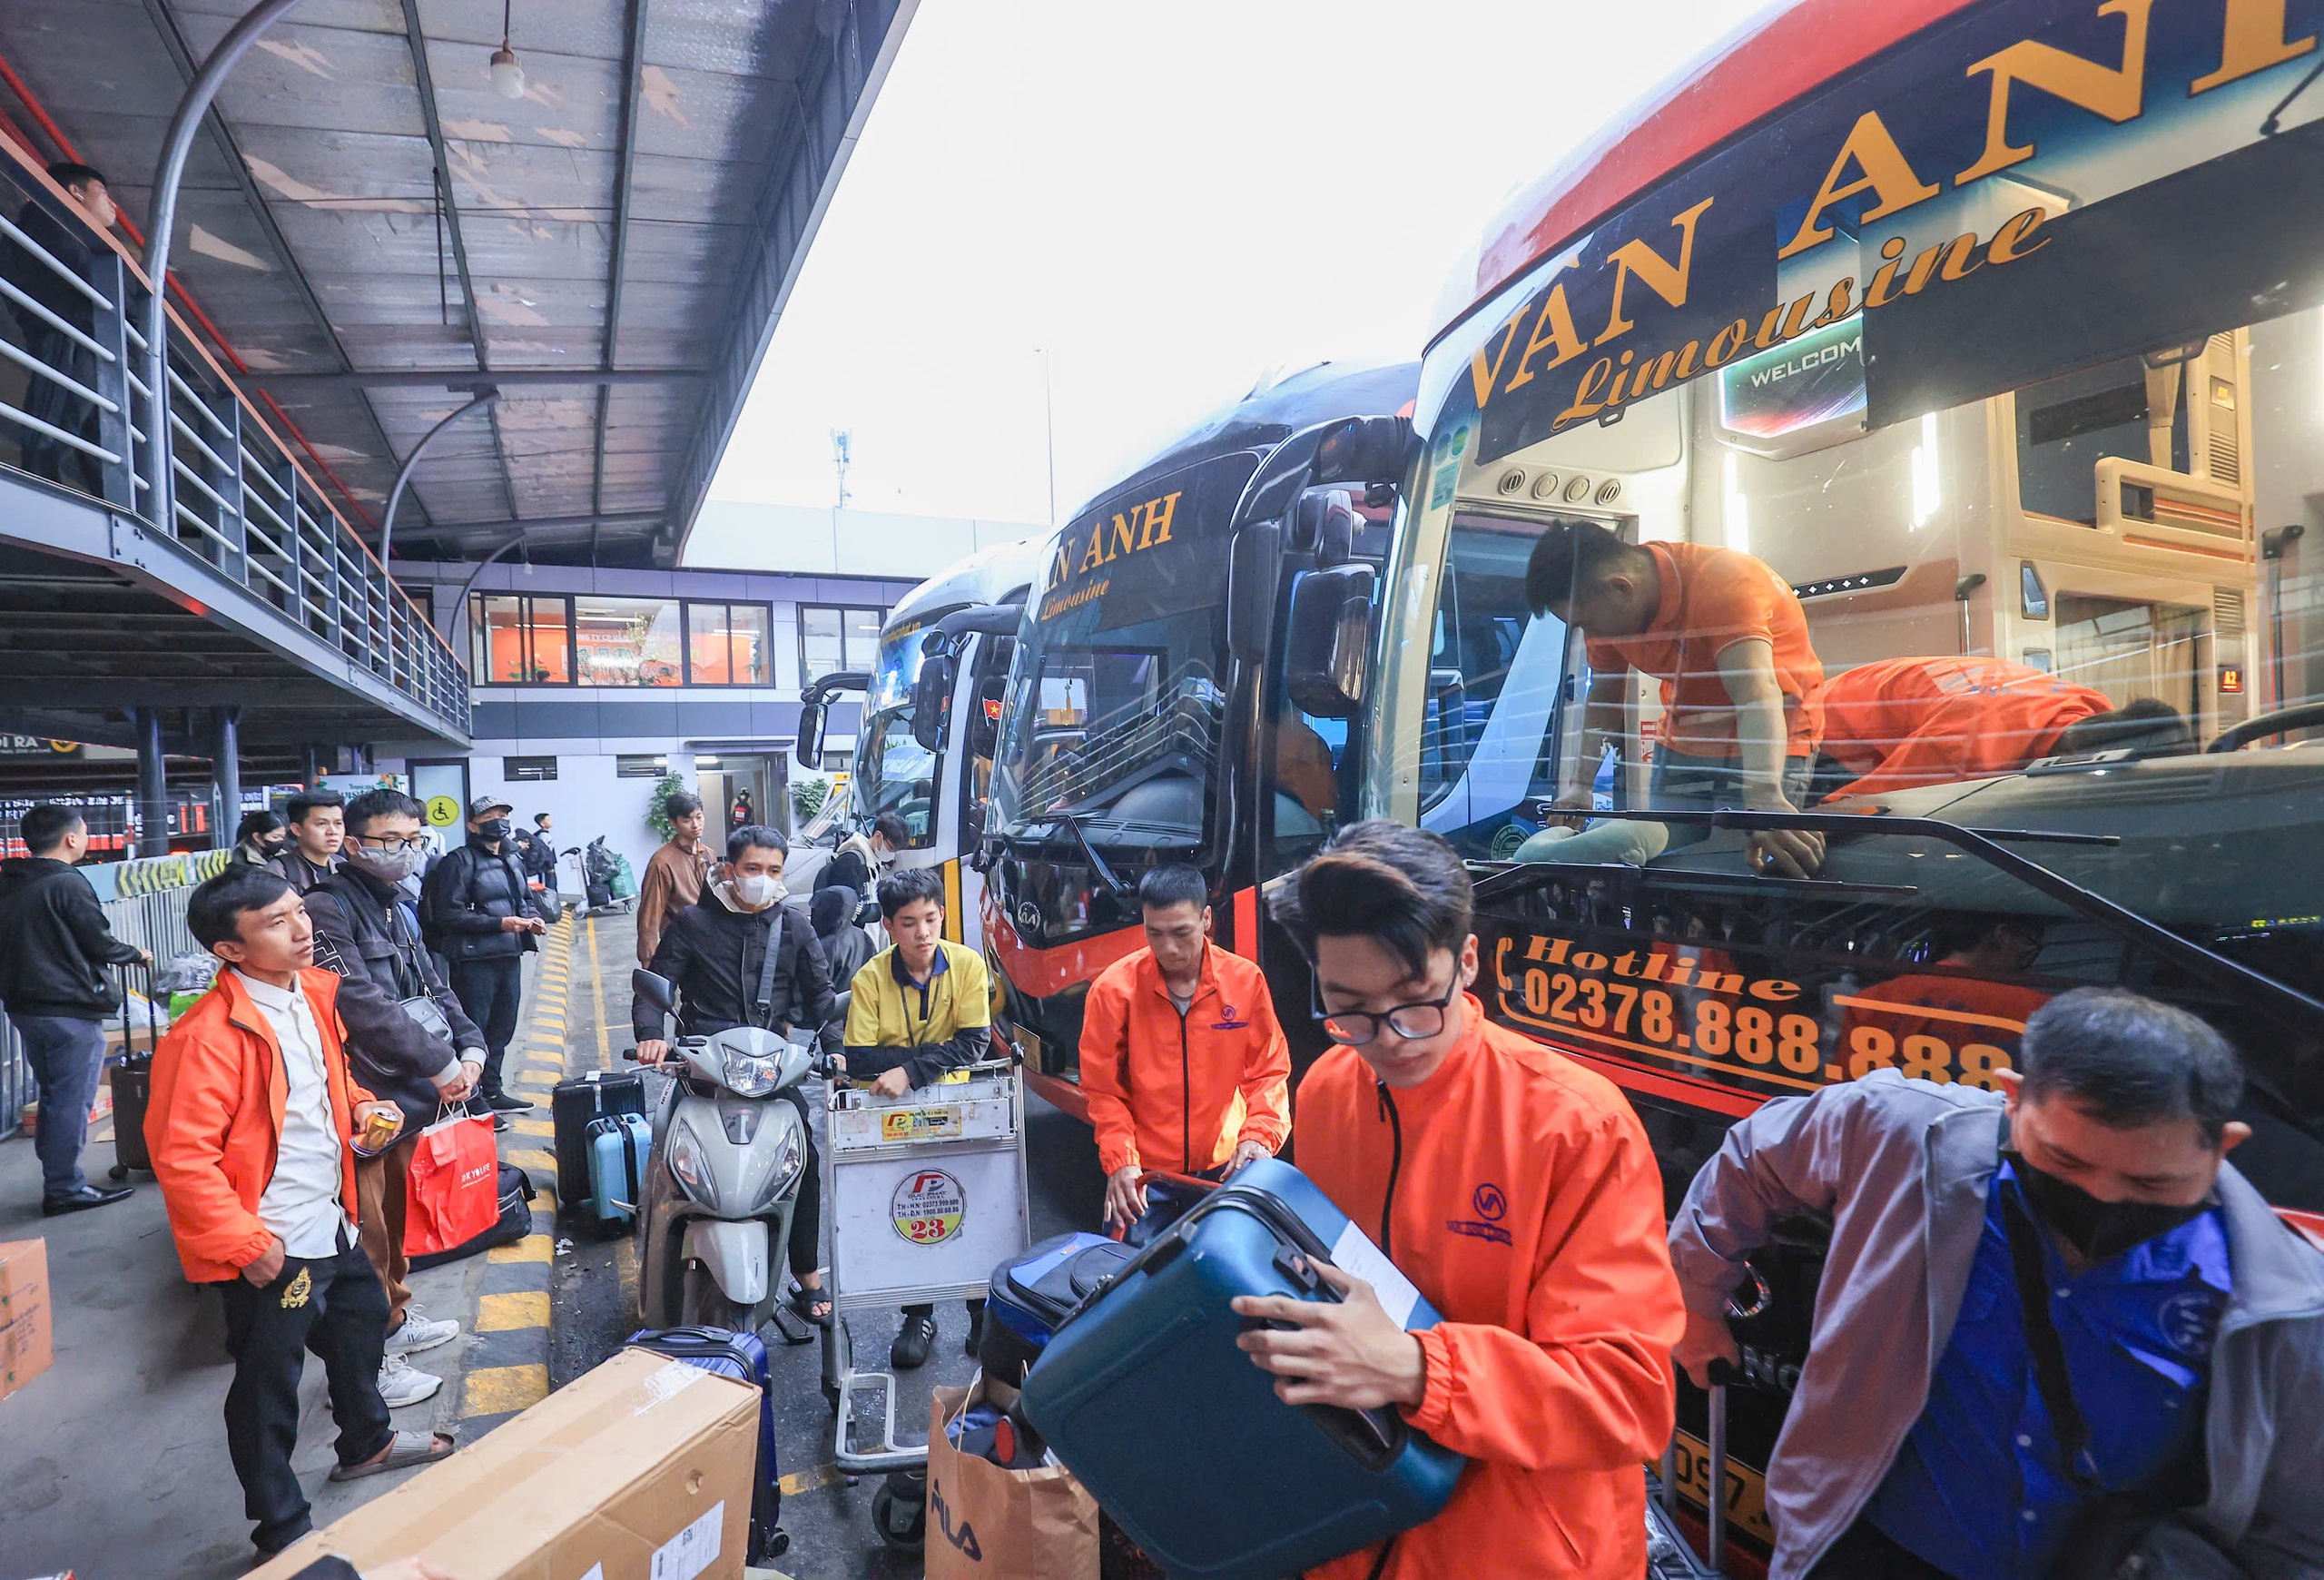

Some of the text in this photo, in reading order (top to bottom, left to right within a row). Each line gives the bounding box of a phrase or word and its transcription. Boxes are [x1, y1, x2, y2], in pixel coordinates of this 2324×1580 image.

[1551, 205, 2052, 431] Limousine
[1750, 336, 1861, 388] WELCOM
[1078, 491, 1182, 574] ANH
[1039, 578, 1109, 622] Limousine
[15, 736, 38, 747] RA
[1523, 934, 1803, 1001] Hotline
[1524, 968, 2013, 1093] 02378.888.888
[911, 1219, 946, 1239] 23
